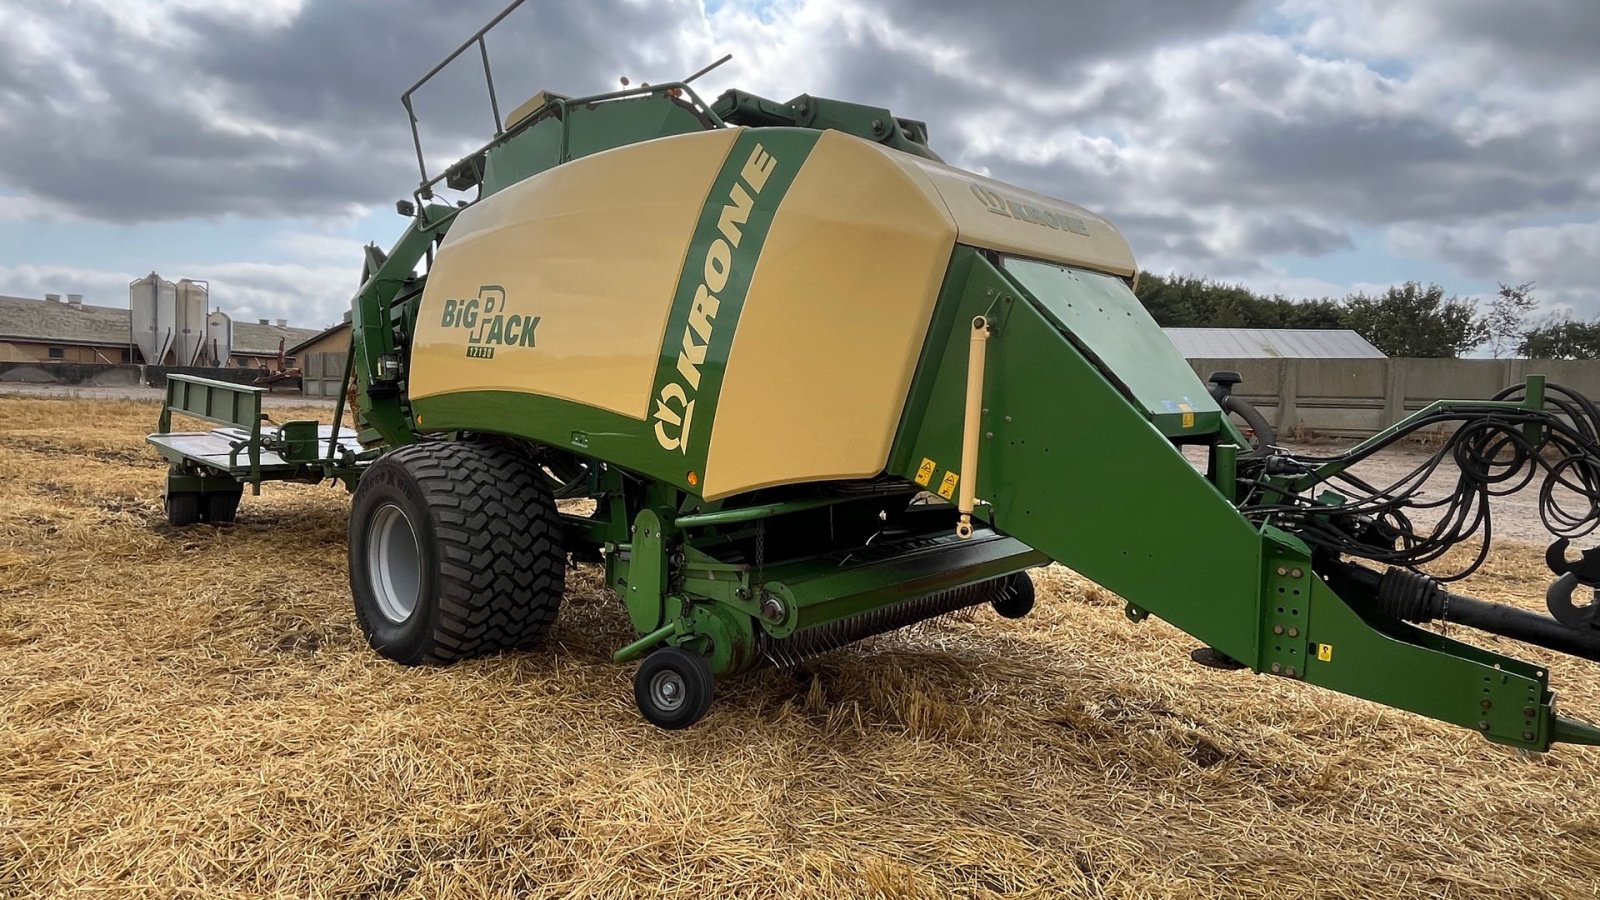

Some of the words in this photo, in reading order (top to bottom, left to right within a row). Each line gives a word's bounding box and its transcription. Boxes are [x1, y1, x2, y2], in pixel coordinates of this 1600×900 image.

[1005, 199, 1090, 236] KRONE
[677, 142, 778, 391] KRONE
[469, 285, 541, 348] PACK
[468, 347, 493, 359] 12130
